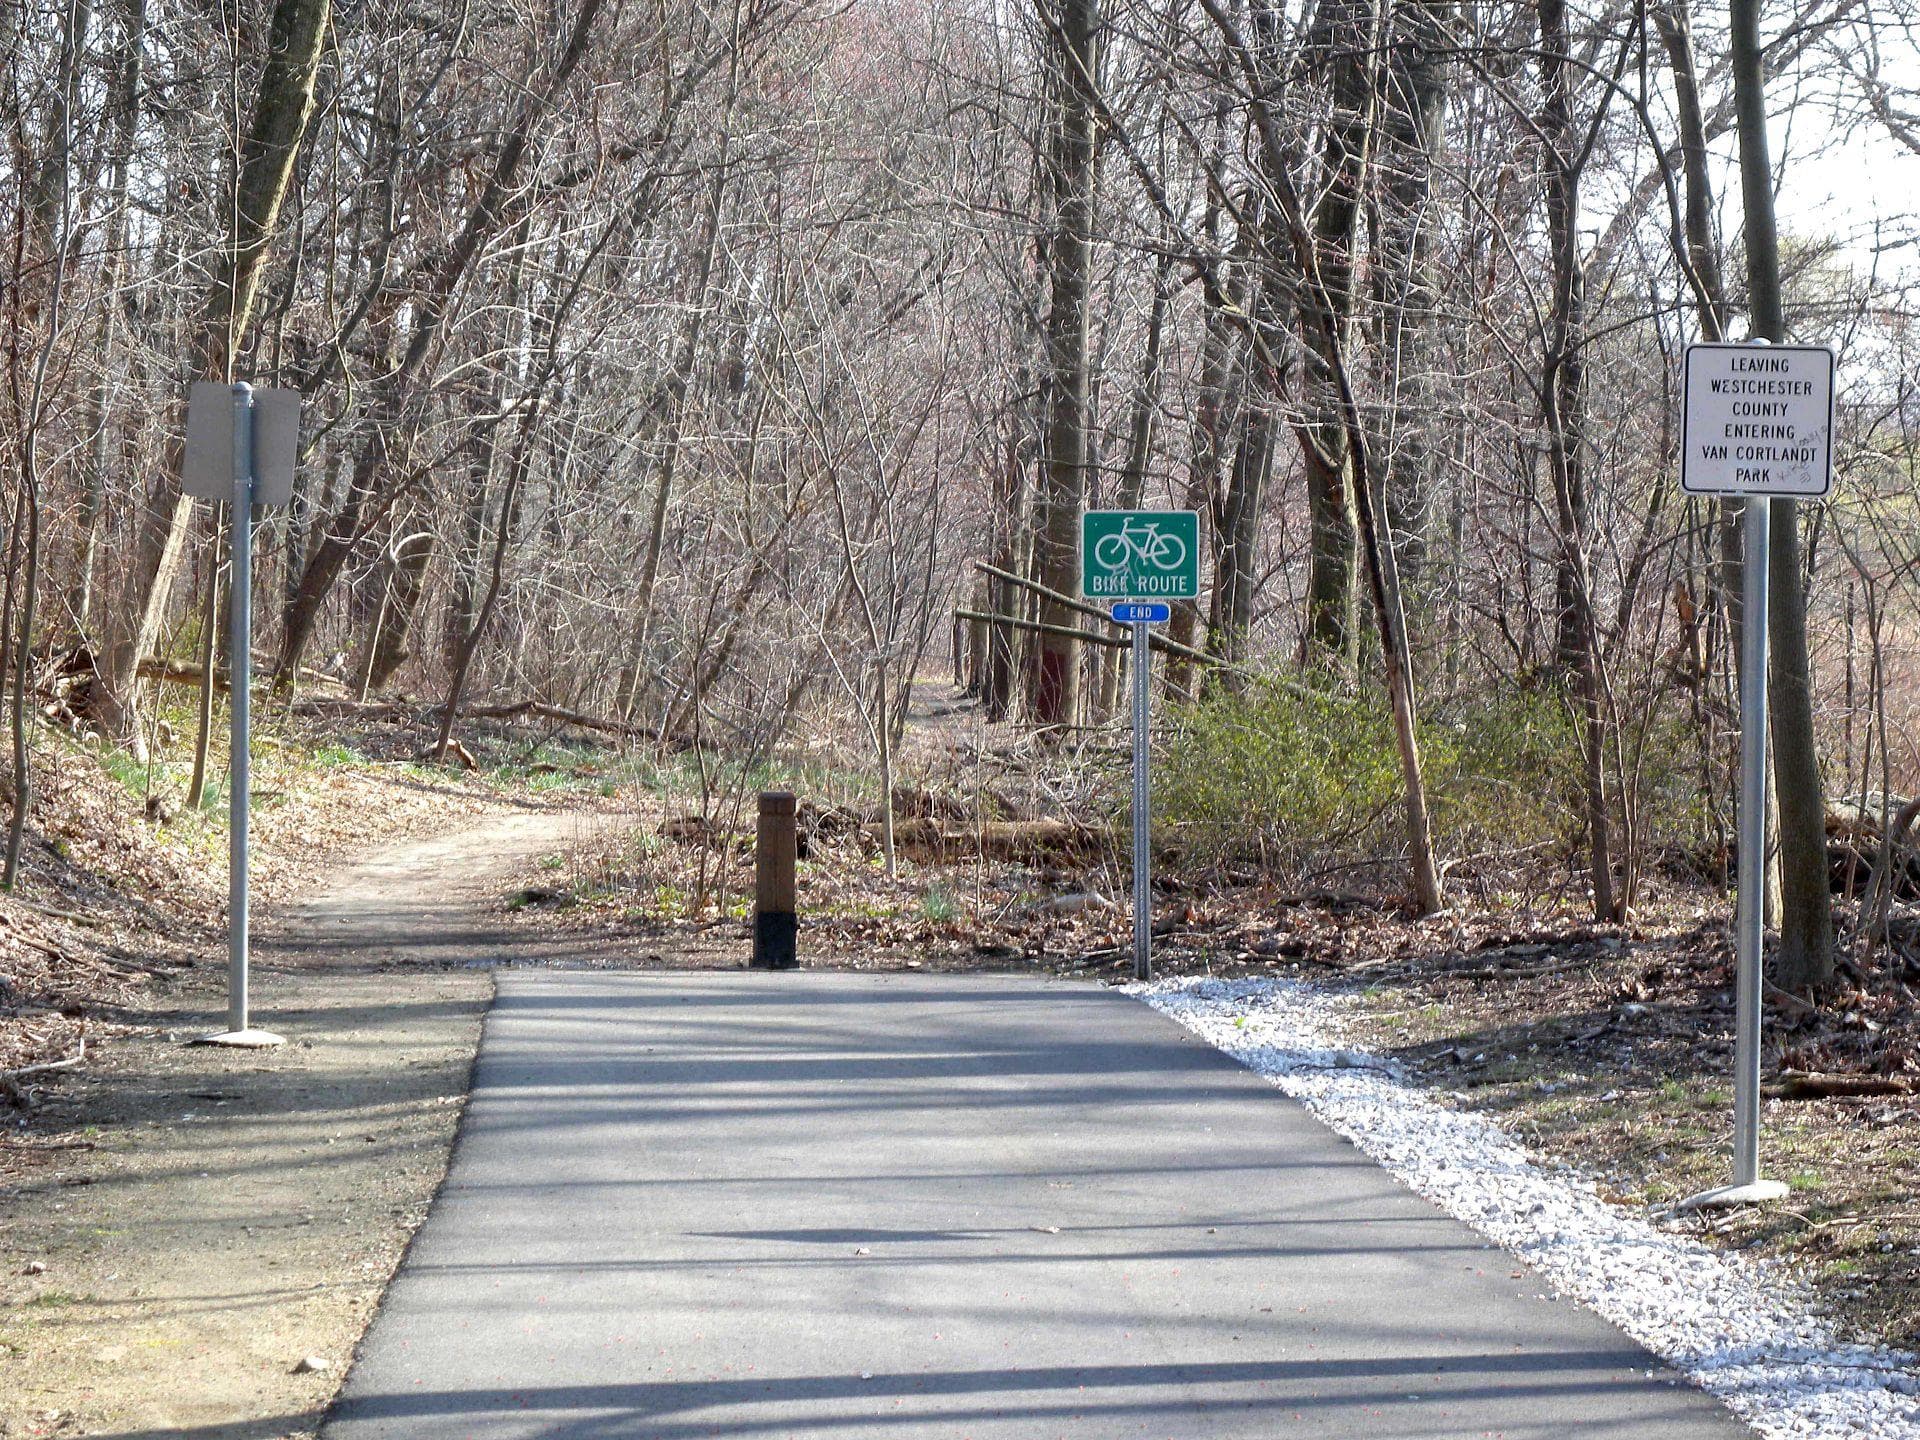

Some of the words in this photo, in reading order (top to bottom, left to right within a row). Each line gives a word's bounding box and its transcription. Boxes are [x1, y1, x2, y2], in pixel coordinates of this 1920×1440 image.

[1731, 358, 1789, 373] LEAVING
[1711, 380, 1812, 395] WESTCHESTER
[1732, 402, 1788, 417] COUNTY
[1725, 424, 1795, 439] ENTERING
[1702, 445, 1728, 460] VAN
[1736, 446, 1817, 462] CORTLANDT
[1736, 468, 1770, 482] PARK
[1093, 575, 1129, 593] BIKE
[1138, 575, 1188, 592] ROUTE
[1130, 606, 1152, 619] END
